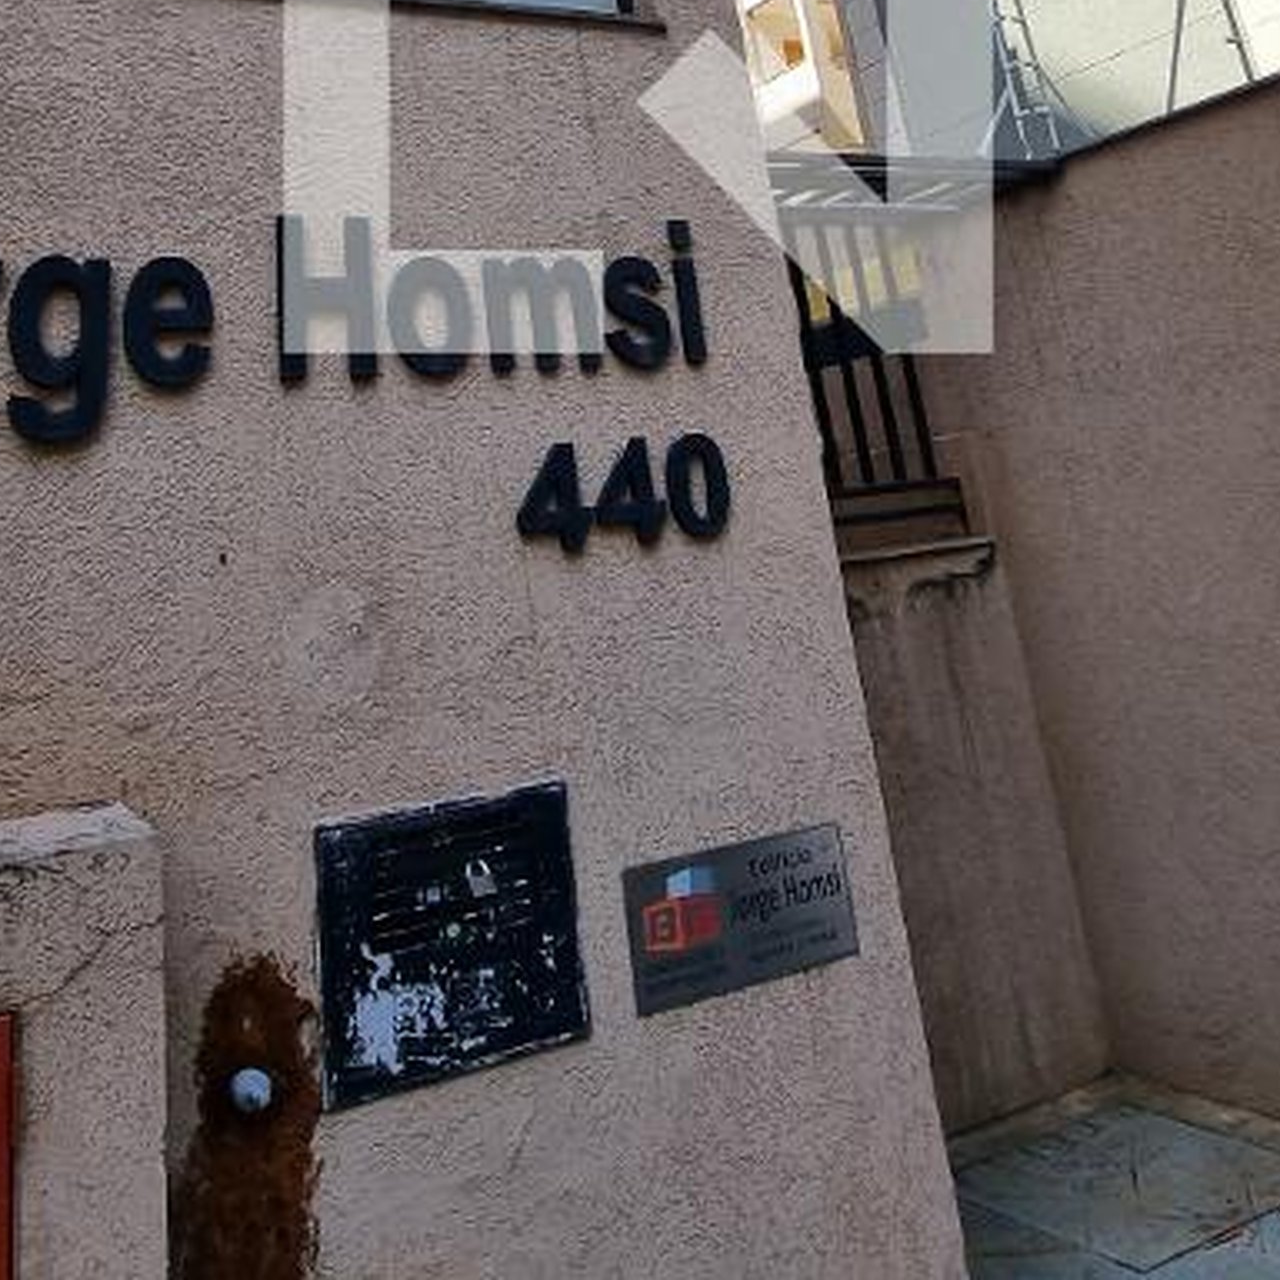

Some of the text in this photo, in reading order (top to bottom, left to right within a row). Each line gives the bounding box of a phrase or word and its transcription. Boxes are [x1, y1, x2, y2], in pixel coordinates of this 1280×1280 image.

[275, 215, 708, 386] Homsi
[516, 433, 730, 554] 440
[782, 860, 842, 907] Homsi
